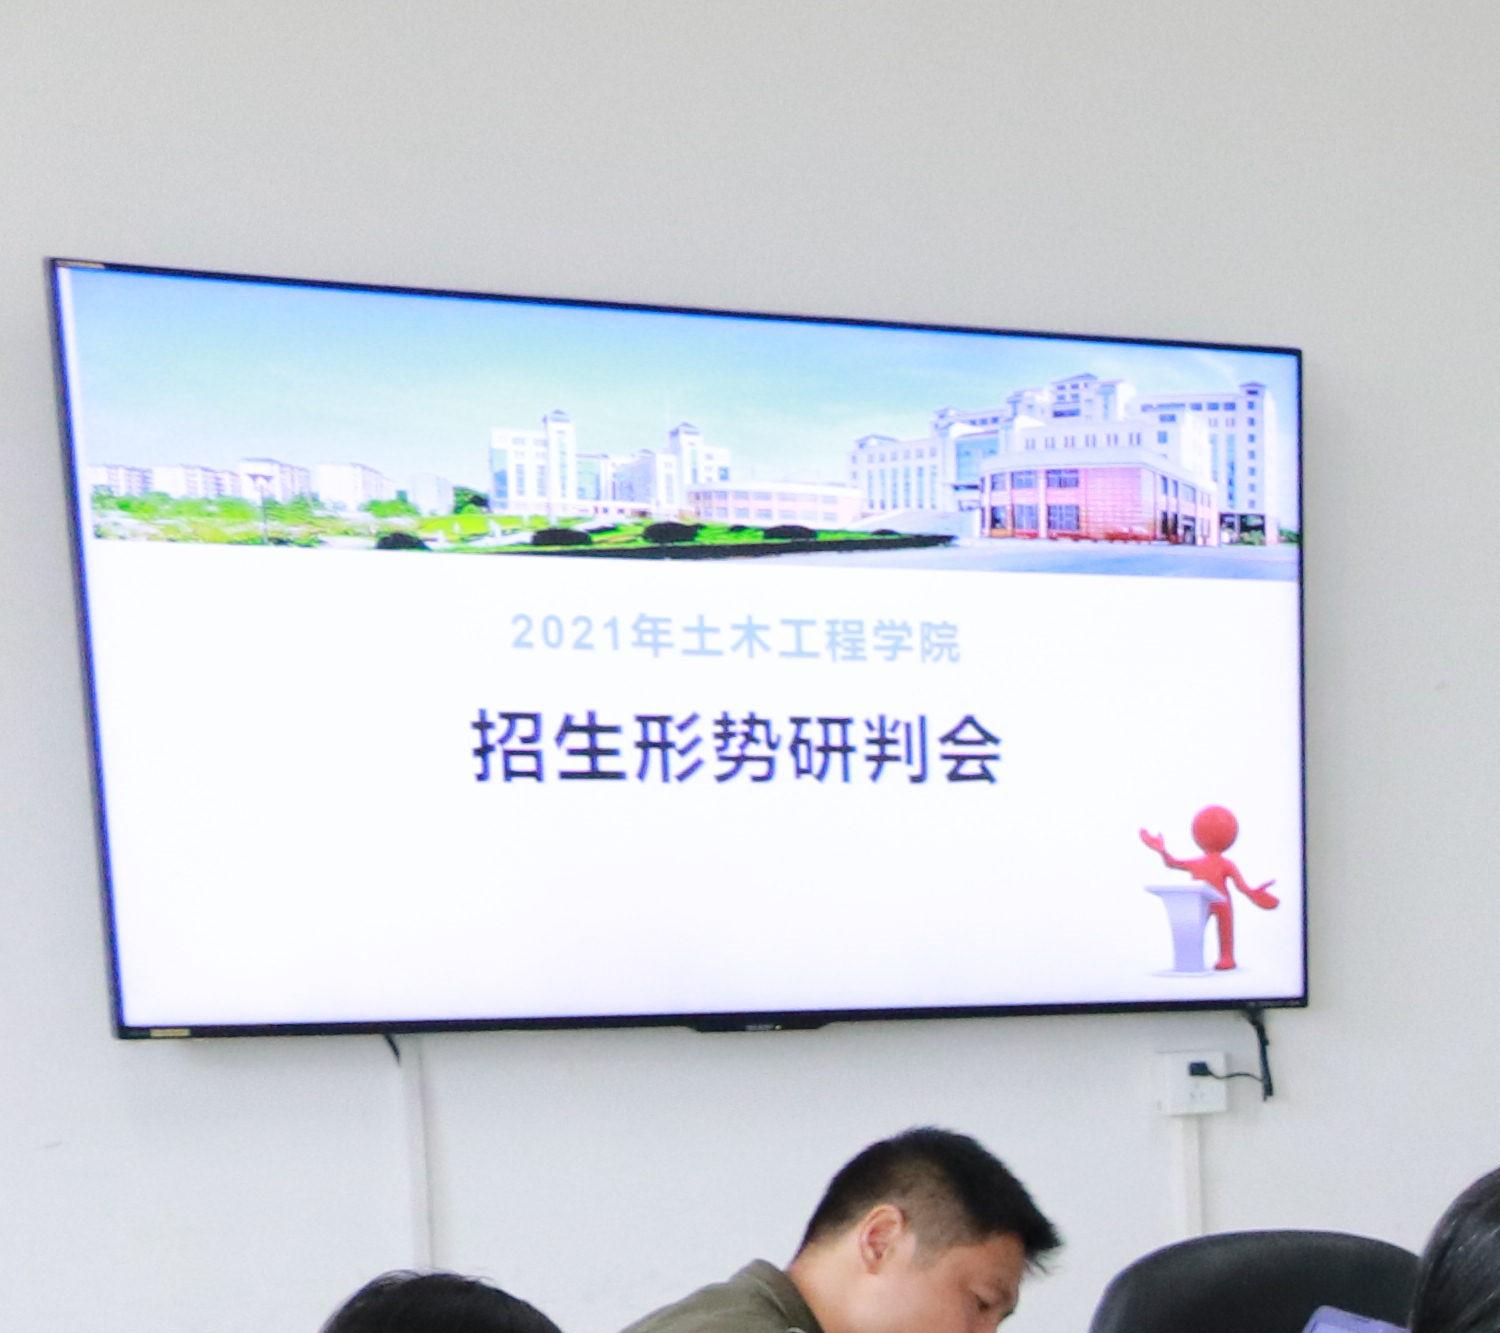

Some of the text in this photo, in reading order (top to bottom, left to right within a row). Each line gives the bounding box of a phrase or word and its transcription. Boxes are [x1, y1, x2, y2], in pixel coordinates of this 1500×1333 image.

[511, 613, 962, 662] 2021年土木工程学院
[470, 709, 1002, 786] 招生形势研判会
